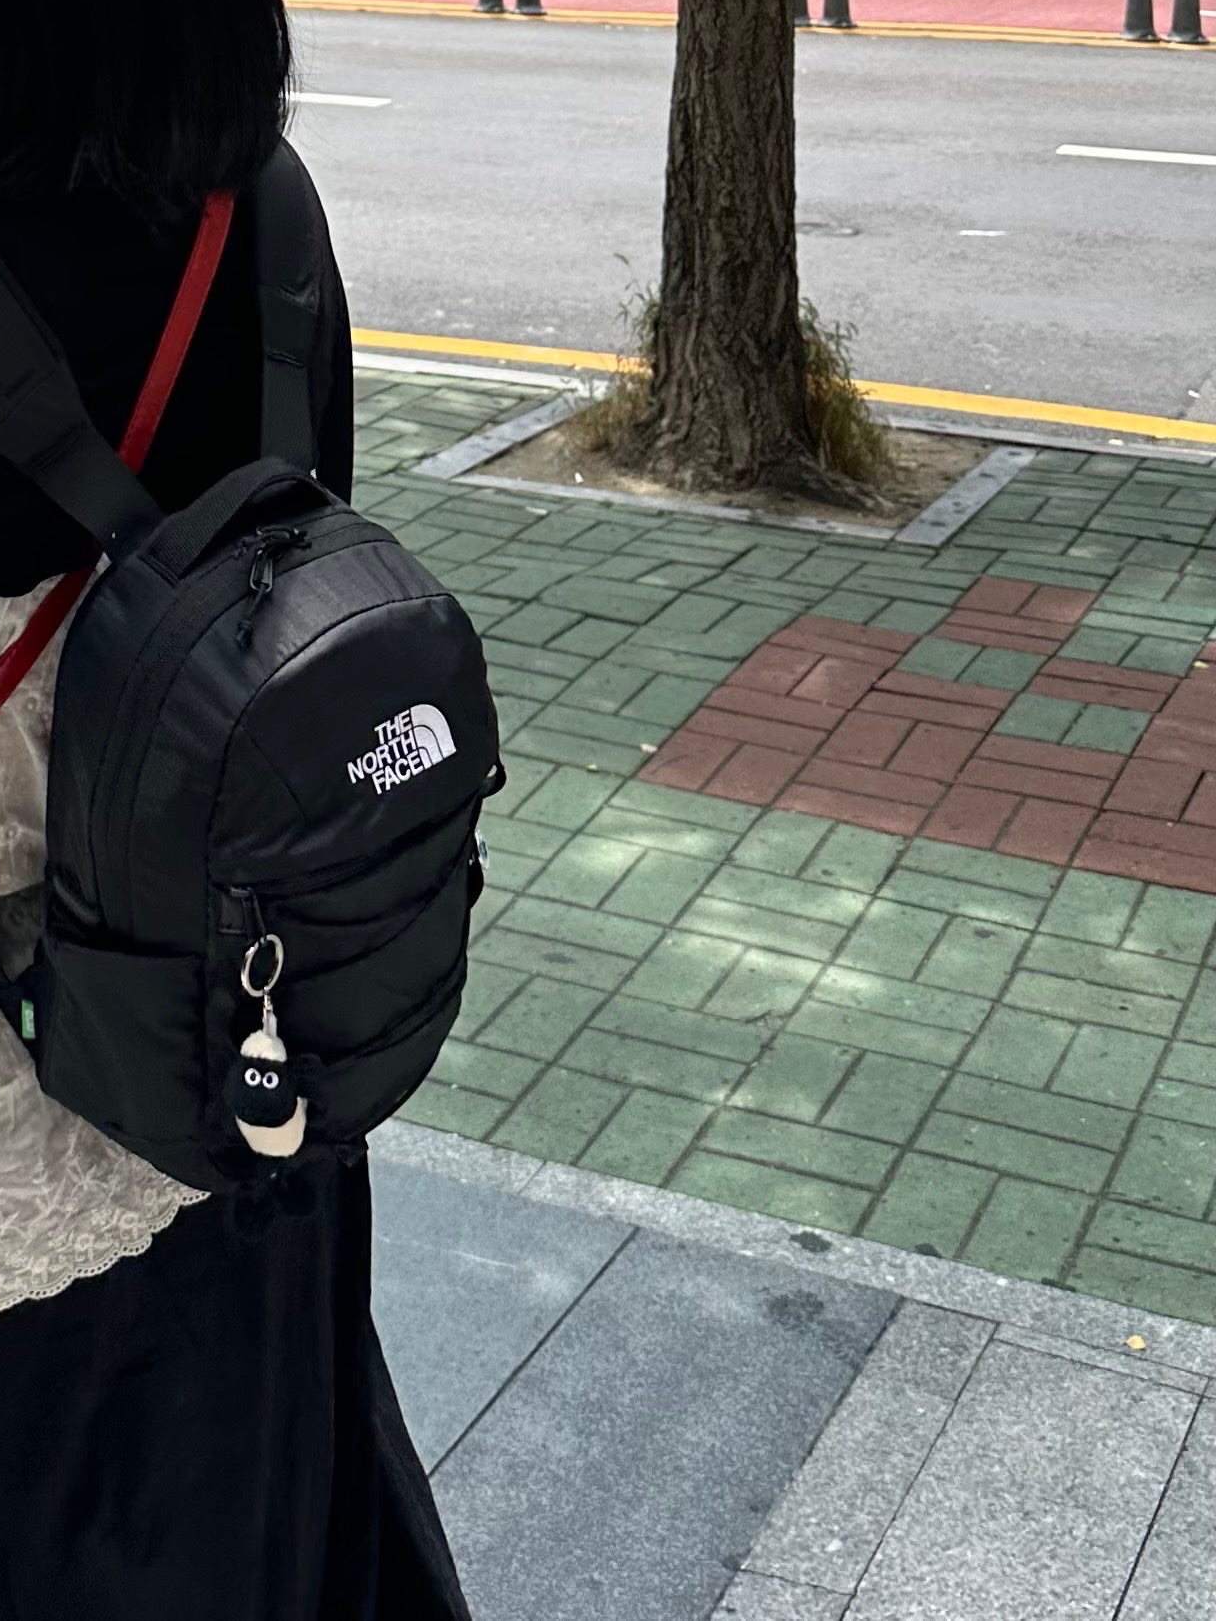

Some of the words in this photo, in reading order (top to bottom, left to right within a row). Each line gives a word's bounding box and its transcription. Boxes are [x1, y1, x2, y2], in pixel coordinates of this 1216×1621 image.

[374, 709, 413, 745] THE
[347, 729, 417, 784] NORTH
[372, 750, 424, 795] FACE
